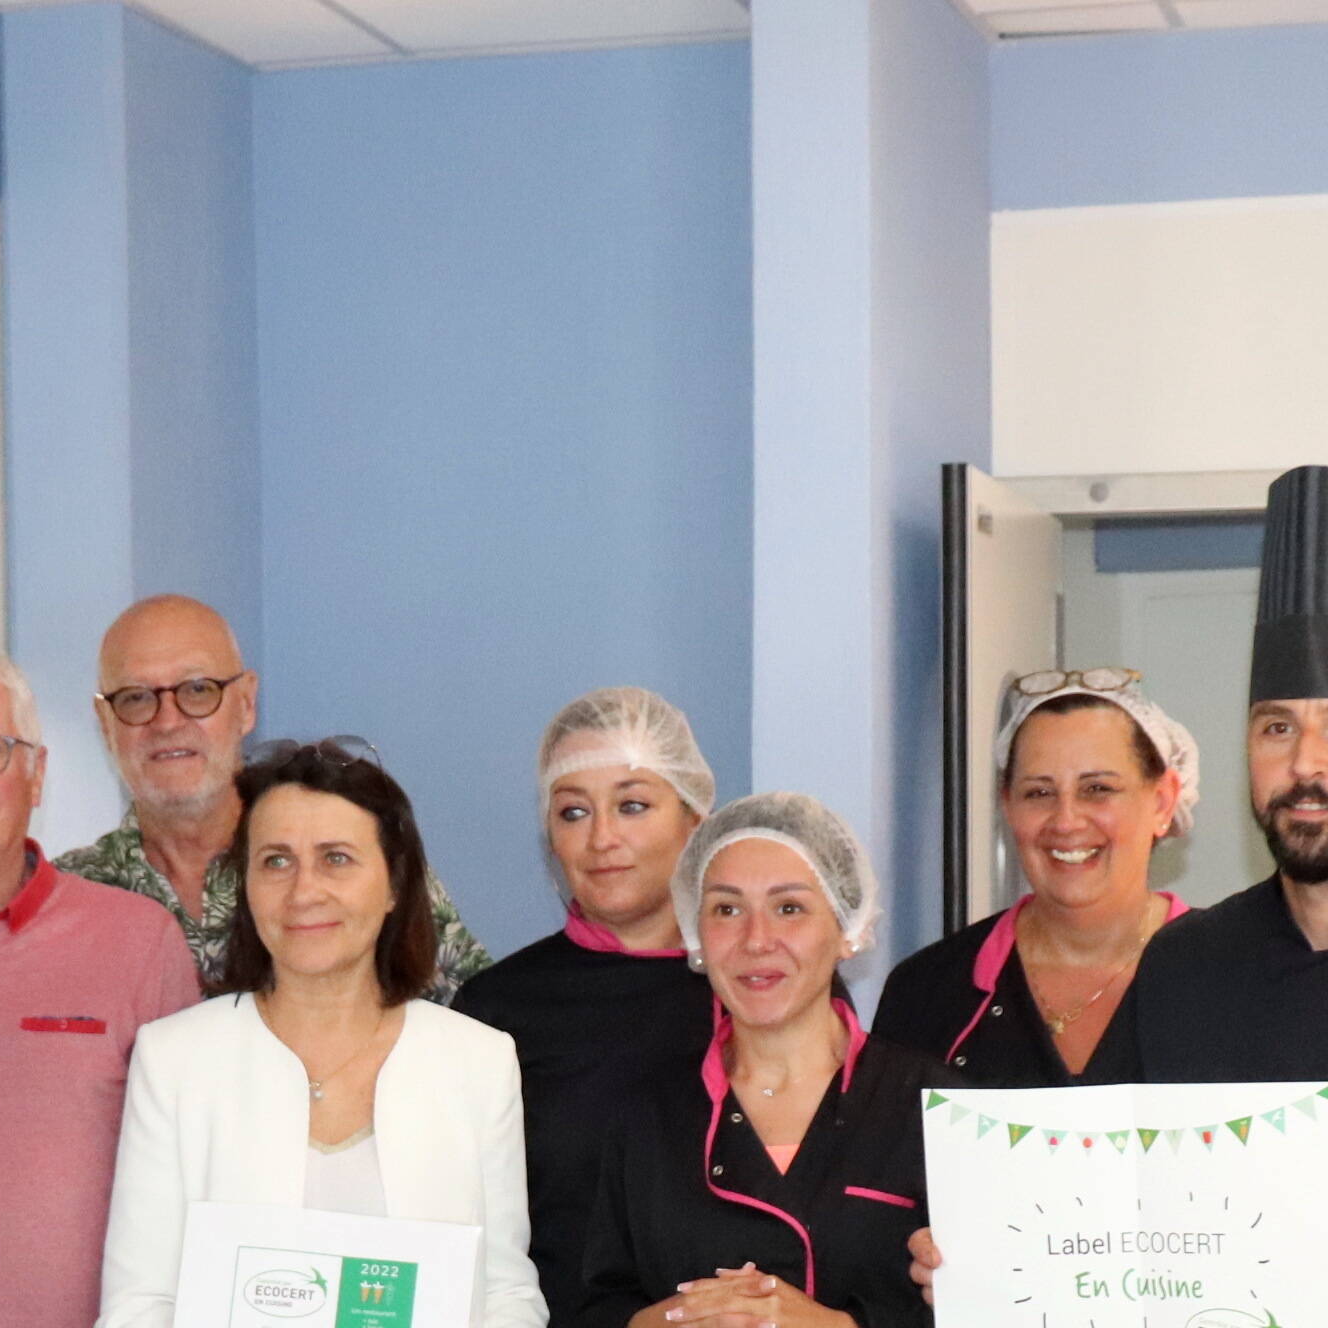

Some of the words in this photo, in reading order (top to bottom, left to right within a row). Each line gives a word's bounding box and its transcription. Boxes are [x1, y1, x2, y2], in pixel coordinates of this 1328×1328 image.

[1047, 1231, 1111, 1256] Label
[1121, 1231, 1226, 1255] ECOCERT
[360, 1263, 400, 1278] 2022
[255, 1285, 315, 1301] ECOCERT
[1075, 1271, 1110, 1299] En
[1122, 1267, 1205, 1302] Cuisine
